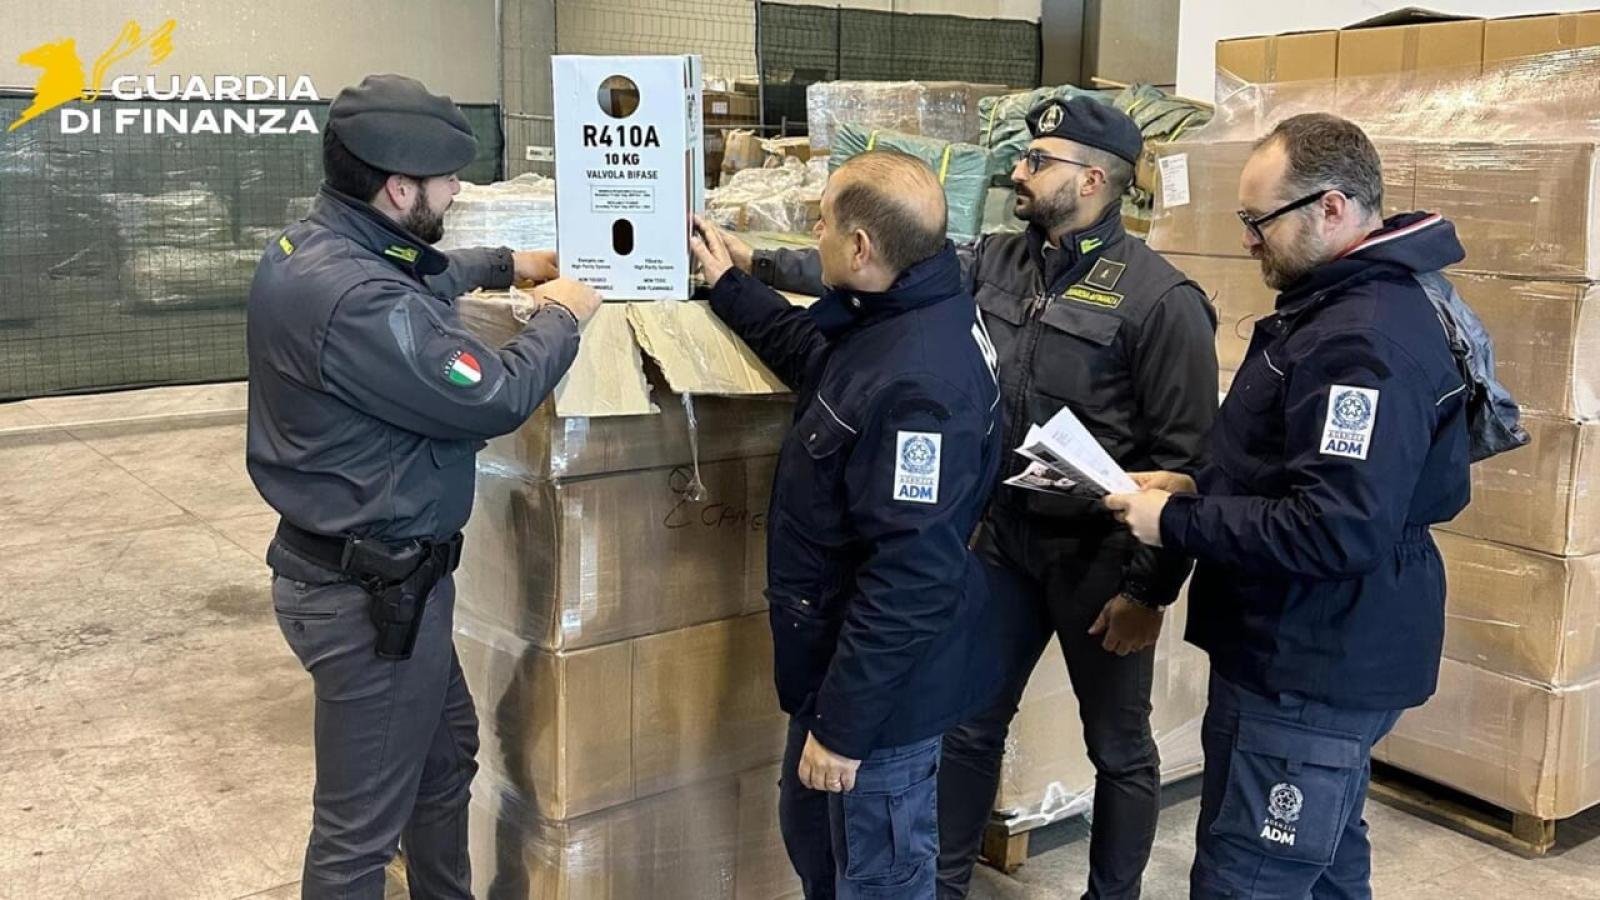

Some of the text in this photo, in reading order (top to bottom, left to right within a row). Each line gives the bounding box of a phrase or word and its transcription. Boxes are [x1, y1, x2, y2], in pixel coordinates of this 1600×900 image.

[583, 125, 660, 147] R410A
[605, 153, 640, 165] 10 KG
[586, 170, 658, 179] VALVOLA BIFASE
[1325, 439, 1362, 455] ADM
[898, 484, 933, 500] ADM
[1260, 825, 1295, 846] ADM
